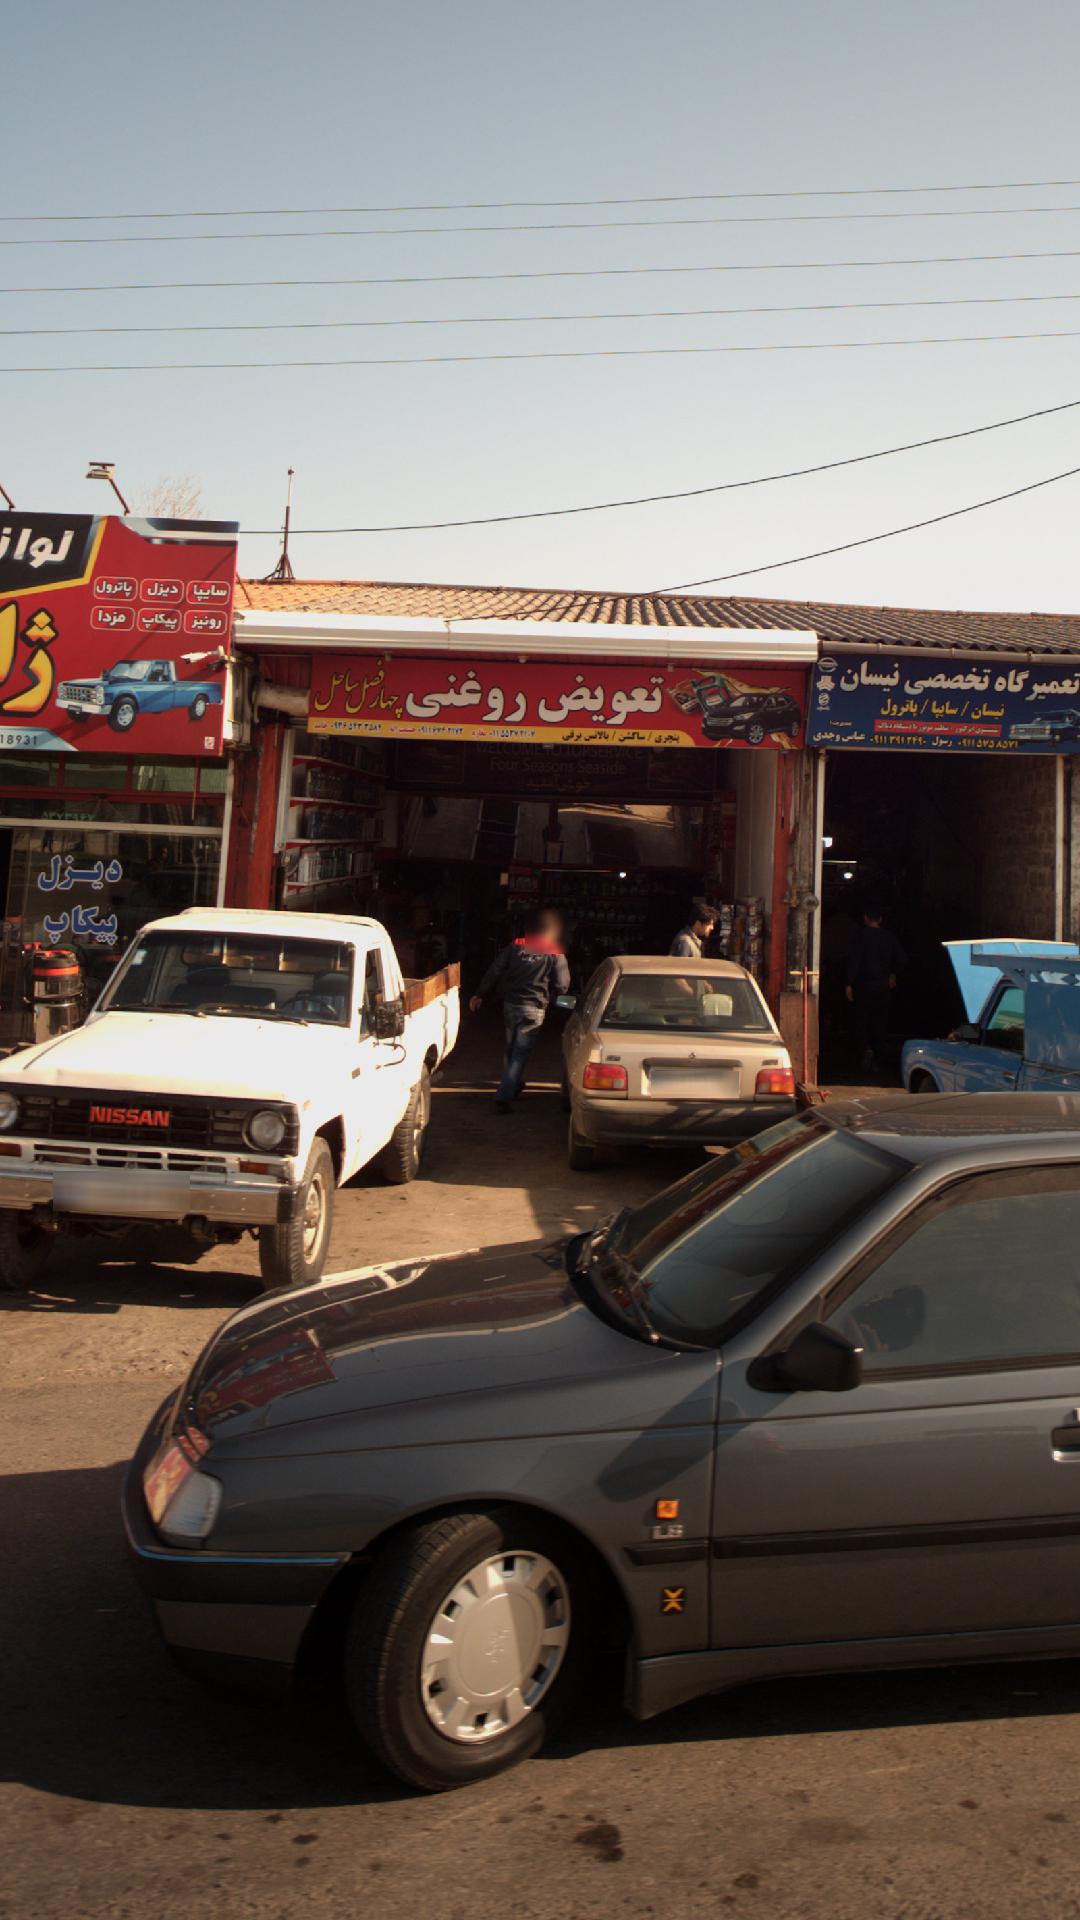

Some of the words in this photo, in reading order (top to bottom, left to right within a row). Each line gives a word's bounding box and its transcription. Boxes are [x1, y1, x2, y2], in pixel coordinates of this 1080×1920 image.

[96, 581, 132, 597] پاترول
[147, 582, 179, 596] دیزل
[193, 584, 227, 601] سایپا
[98, 610, 126, 626] مزدا
[142, 613, 177, 629] پیکاپ
[191, 615, 222, 629] رونیز
[840, 660, 900, 692] نیسان
[904, 667, 992, 695] تخصصی
[345, 660, 385, 714] فصل
[405, 670, 527, 722] روغنی
[538, 674, 665, 725] تعویض
[881, 698, 918, 717] پاترول
[931, 701, 958, 718] سایپا
[971, 703, 1005, 720] نیسان
[931, 736, 952, 747] رسول
[38, 855, 123, 891] دیزل
[43, 905, 118, 945] پیکاپ
[89, 1106, 170, 1127] NISSAN
